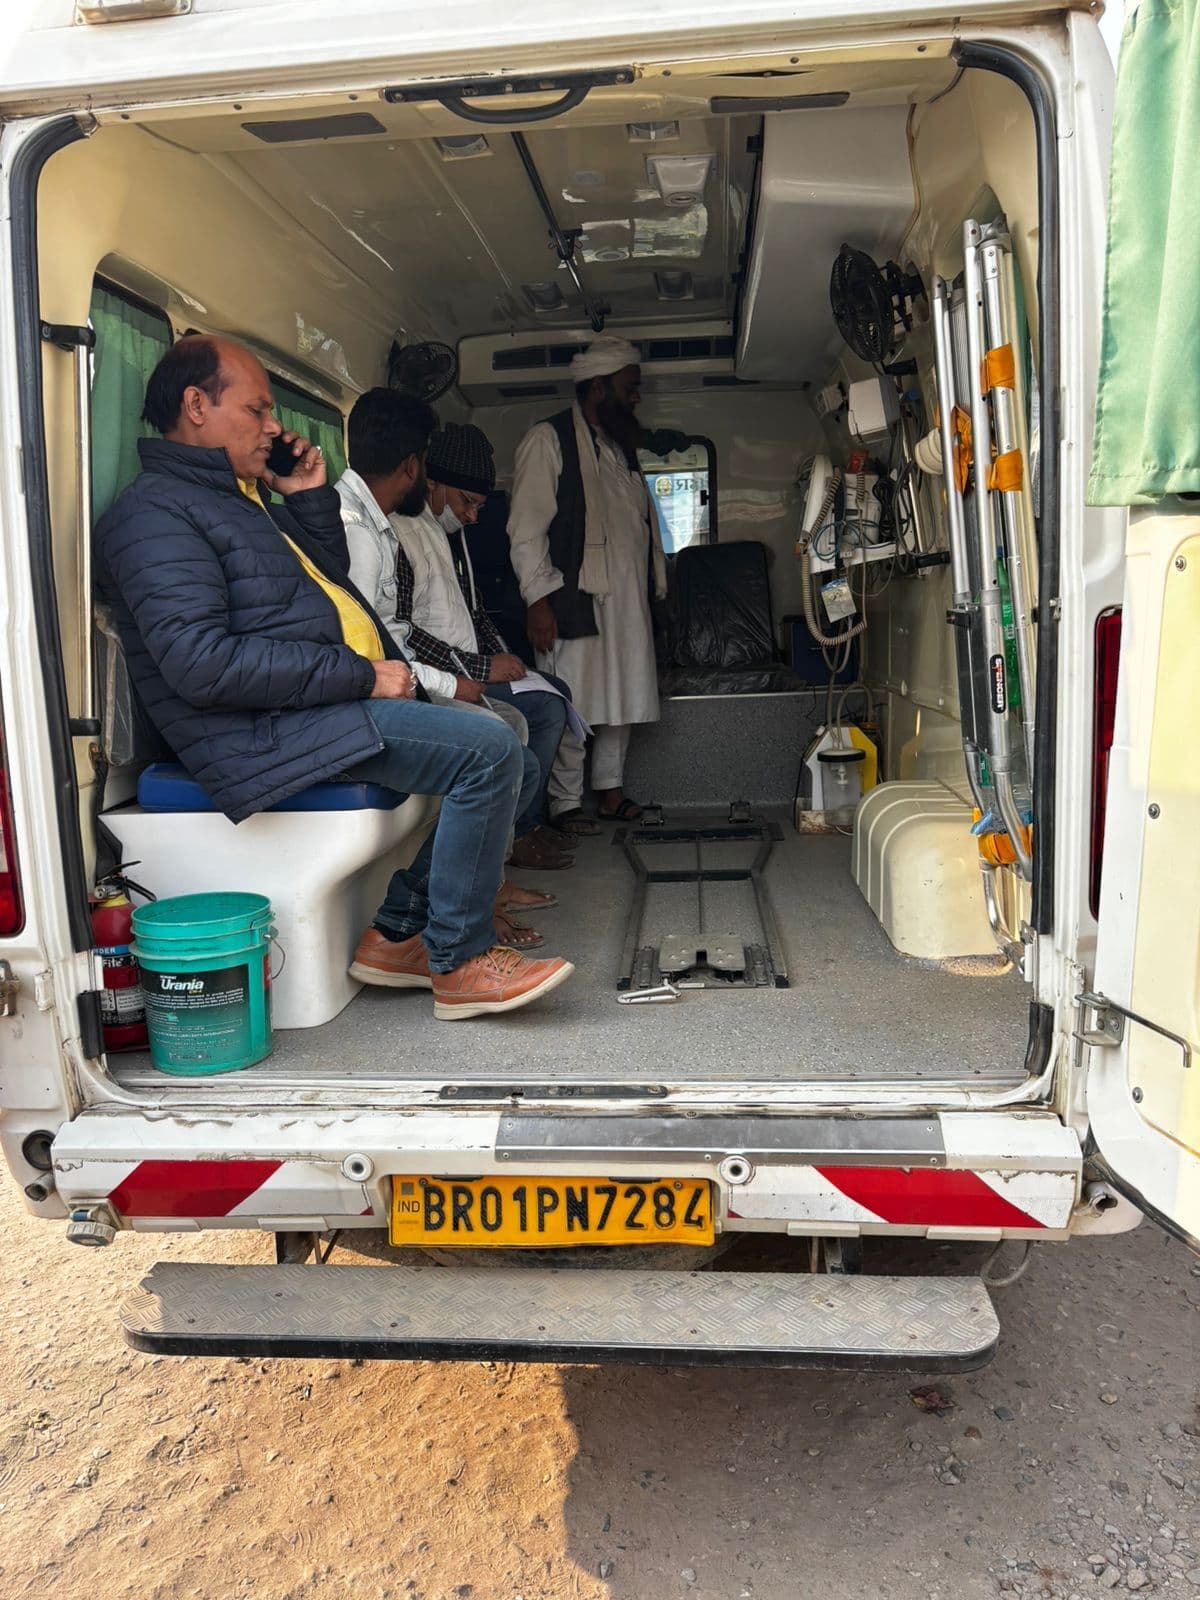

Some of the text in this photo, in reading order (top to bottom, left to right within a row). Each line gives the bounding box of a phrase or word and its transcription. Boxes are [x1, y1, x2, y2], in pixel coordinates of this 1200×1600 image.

[161, 979, 204, 991] Urania
[397, 1200, 420, 1213] IND
[424, 1185, 705, 1232] BR01PN7284
